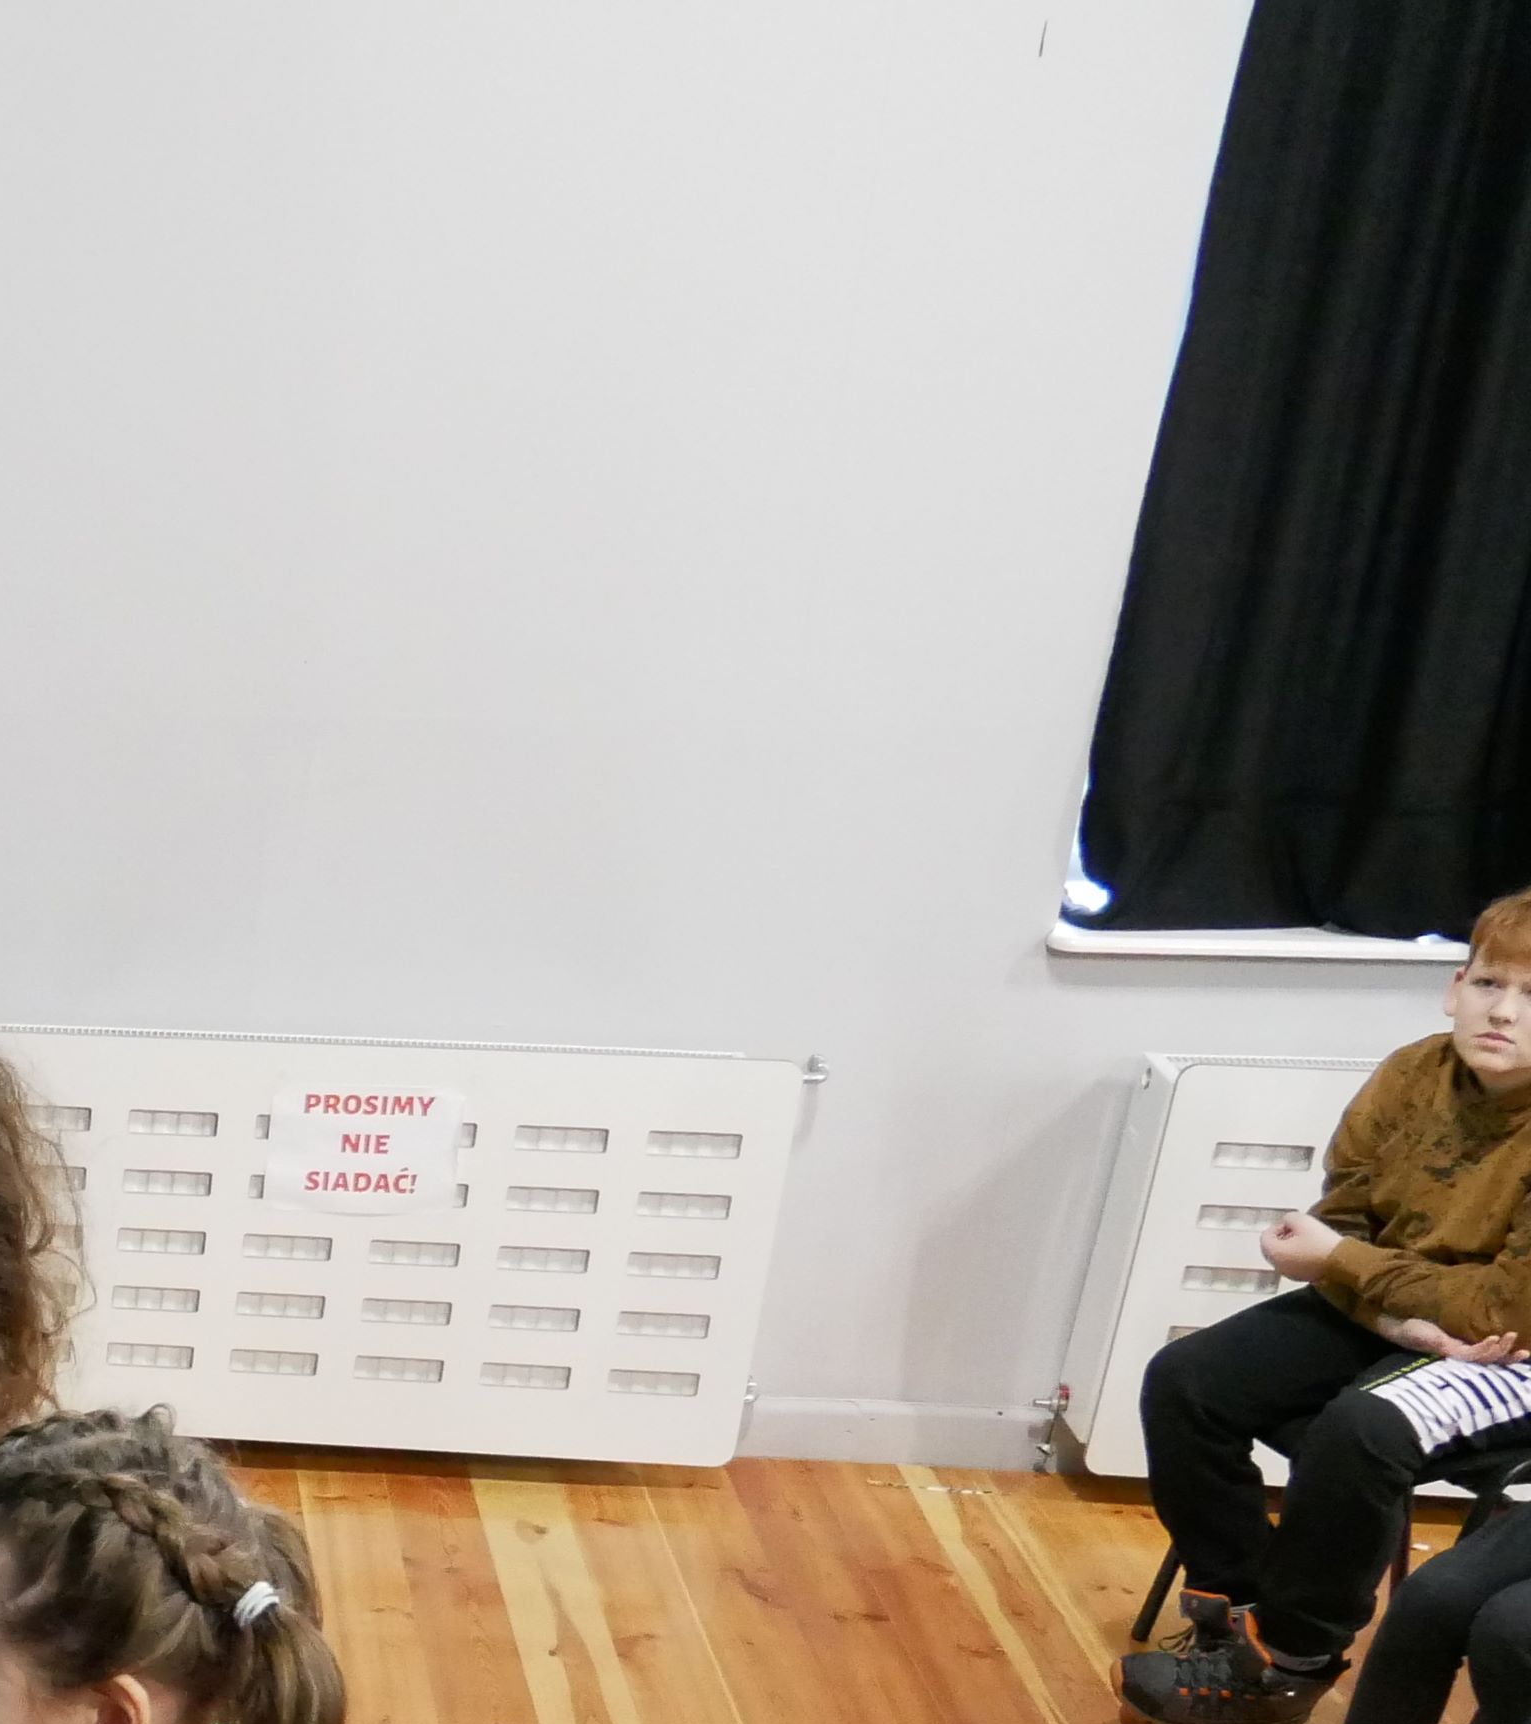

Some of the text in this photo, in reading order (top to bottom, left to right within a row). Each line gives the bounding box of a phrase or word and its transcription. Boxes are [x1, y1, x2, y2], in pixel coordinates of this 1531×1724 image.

[303, 1093, 435, 1117] PROSIMY
[340, 1134, 390, 1154] NIE
[303, 1167, 418, 1194] SIADAĆ!
